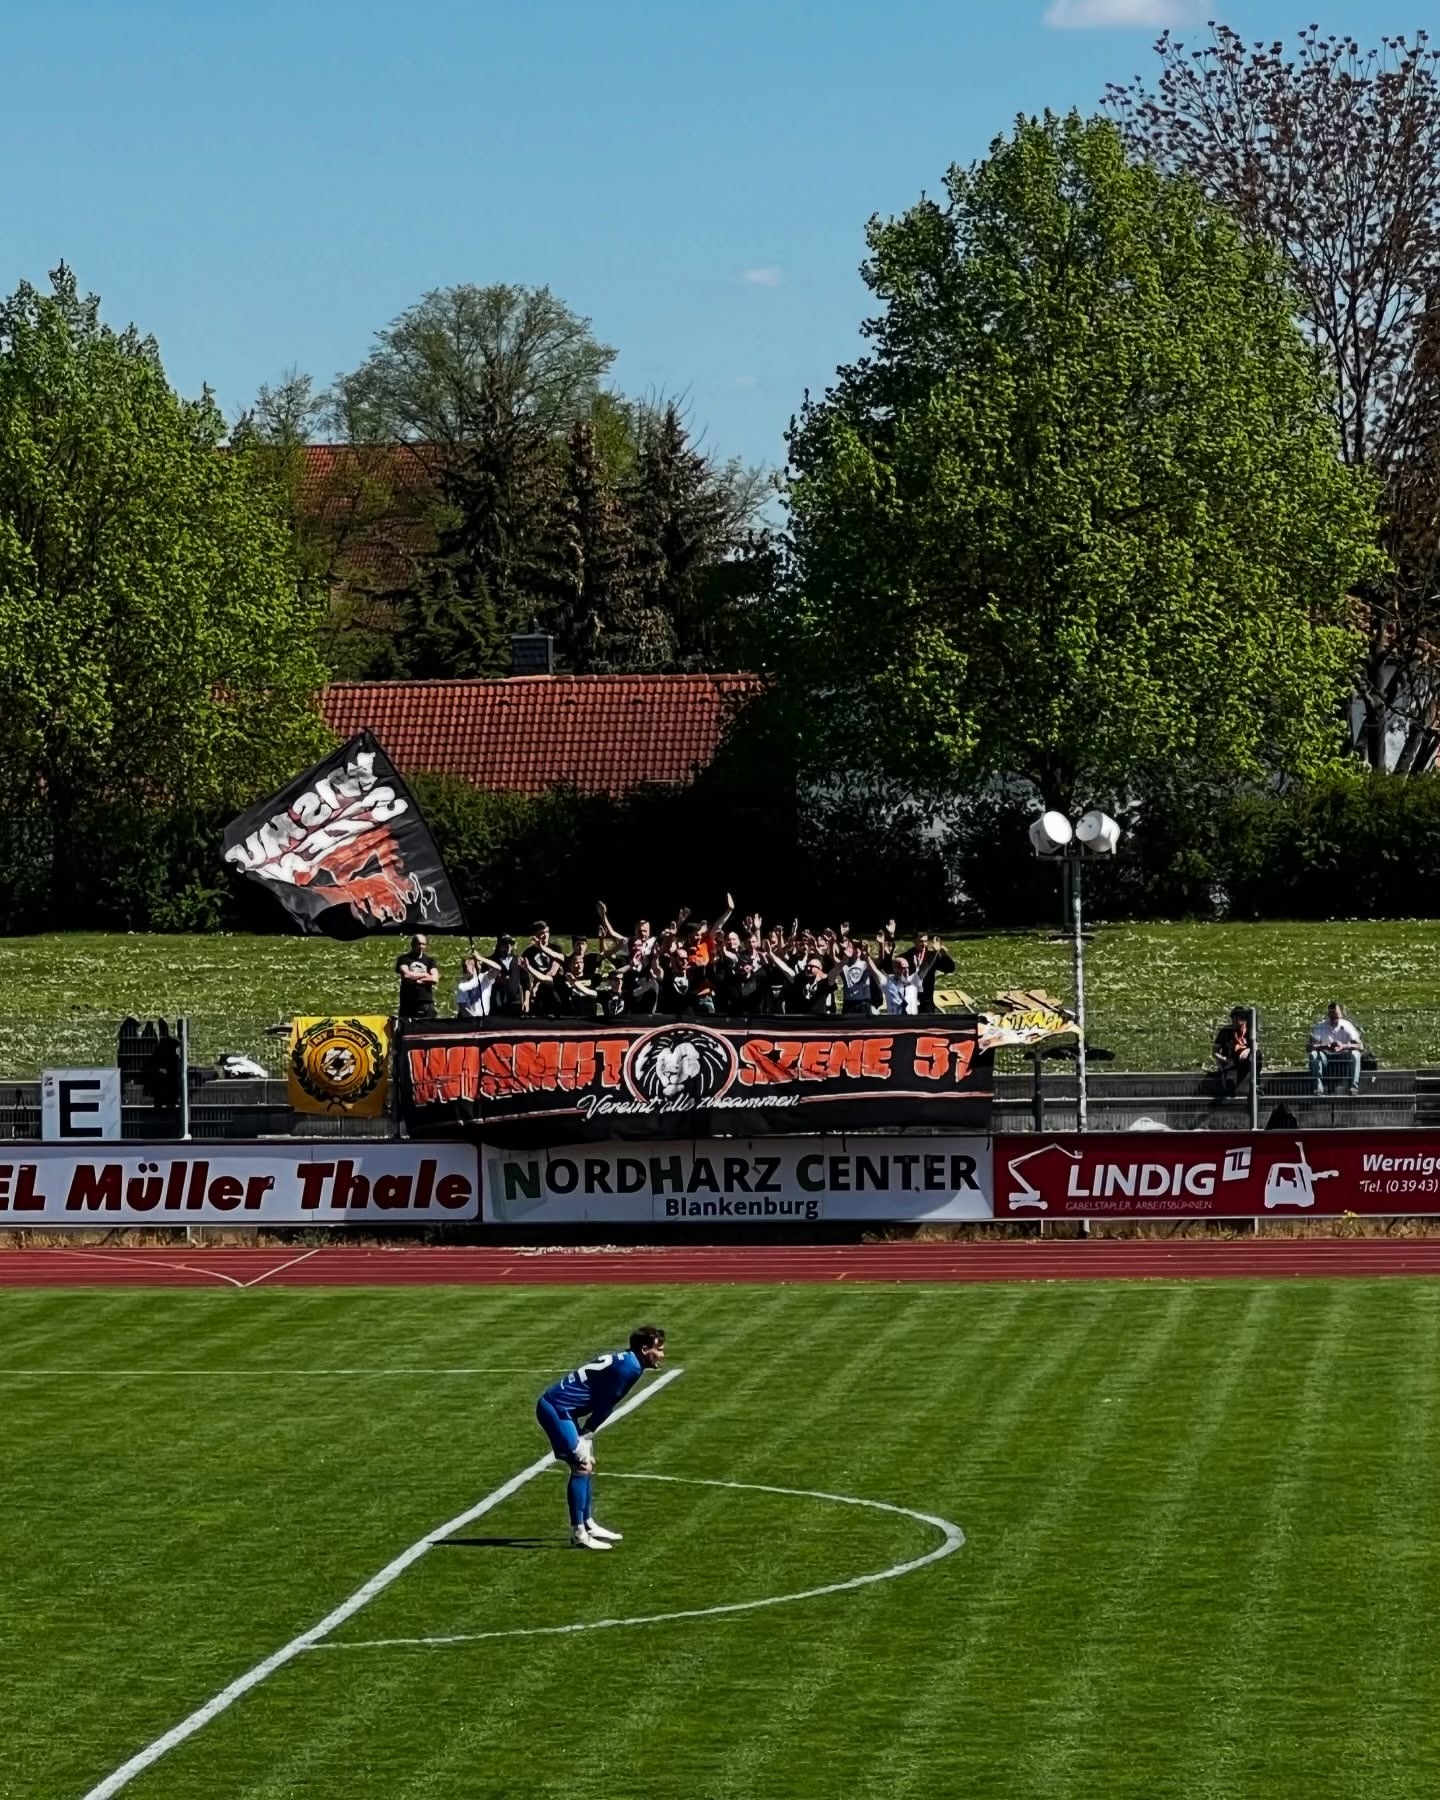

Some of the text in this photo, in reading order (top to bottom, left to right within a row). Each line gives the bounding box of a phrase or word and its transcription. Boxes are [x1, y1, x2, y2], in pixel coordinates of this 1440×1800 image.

[408, 1037, 975, 1106] WISMUT SZENE 51
[59, 1080, 103, 1137] E
[577, 1095, 661, 1121] Vereint
[697, 1094, 801, 1110] zusammen
[65, 1160, 276, 1212] Müller
[297, 1159, 473, 1210] Thale
[503, 1153, 981, 1200] NORDHARZ CENTER
[1067, 1163, 1217, 1197] LINDIG
[665, 1196, 819, 1219] Blankenburg
